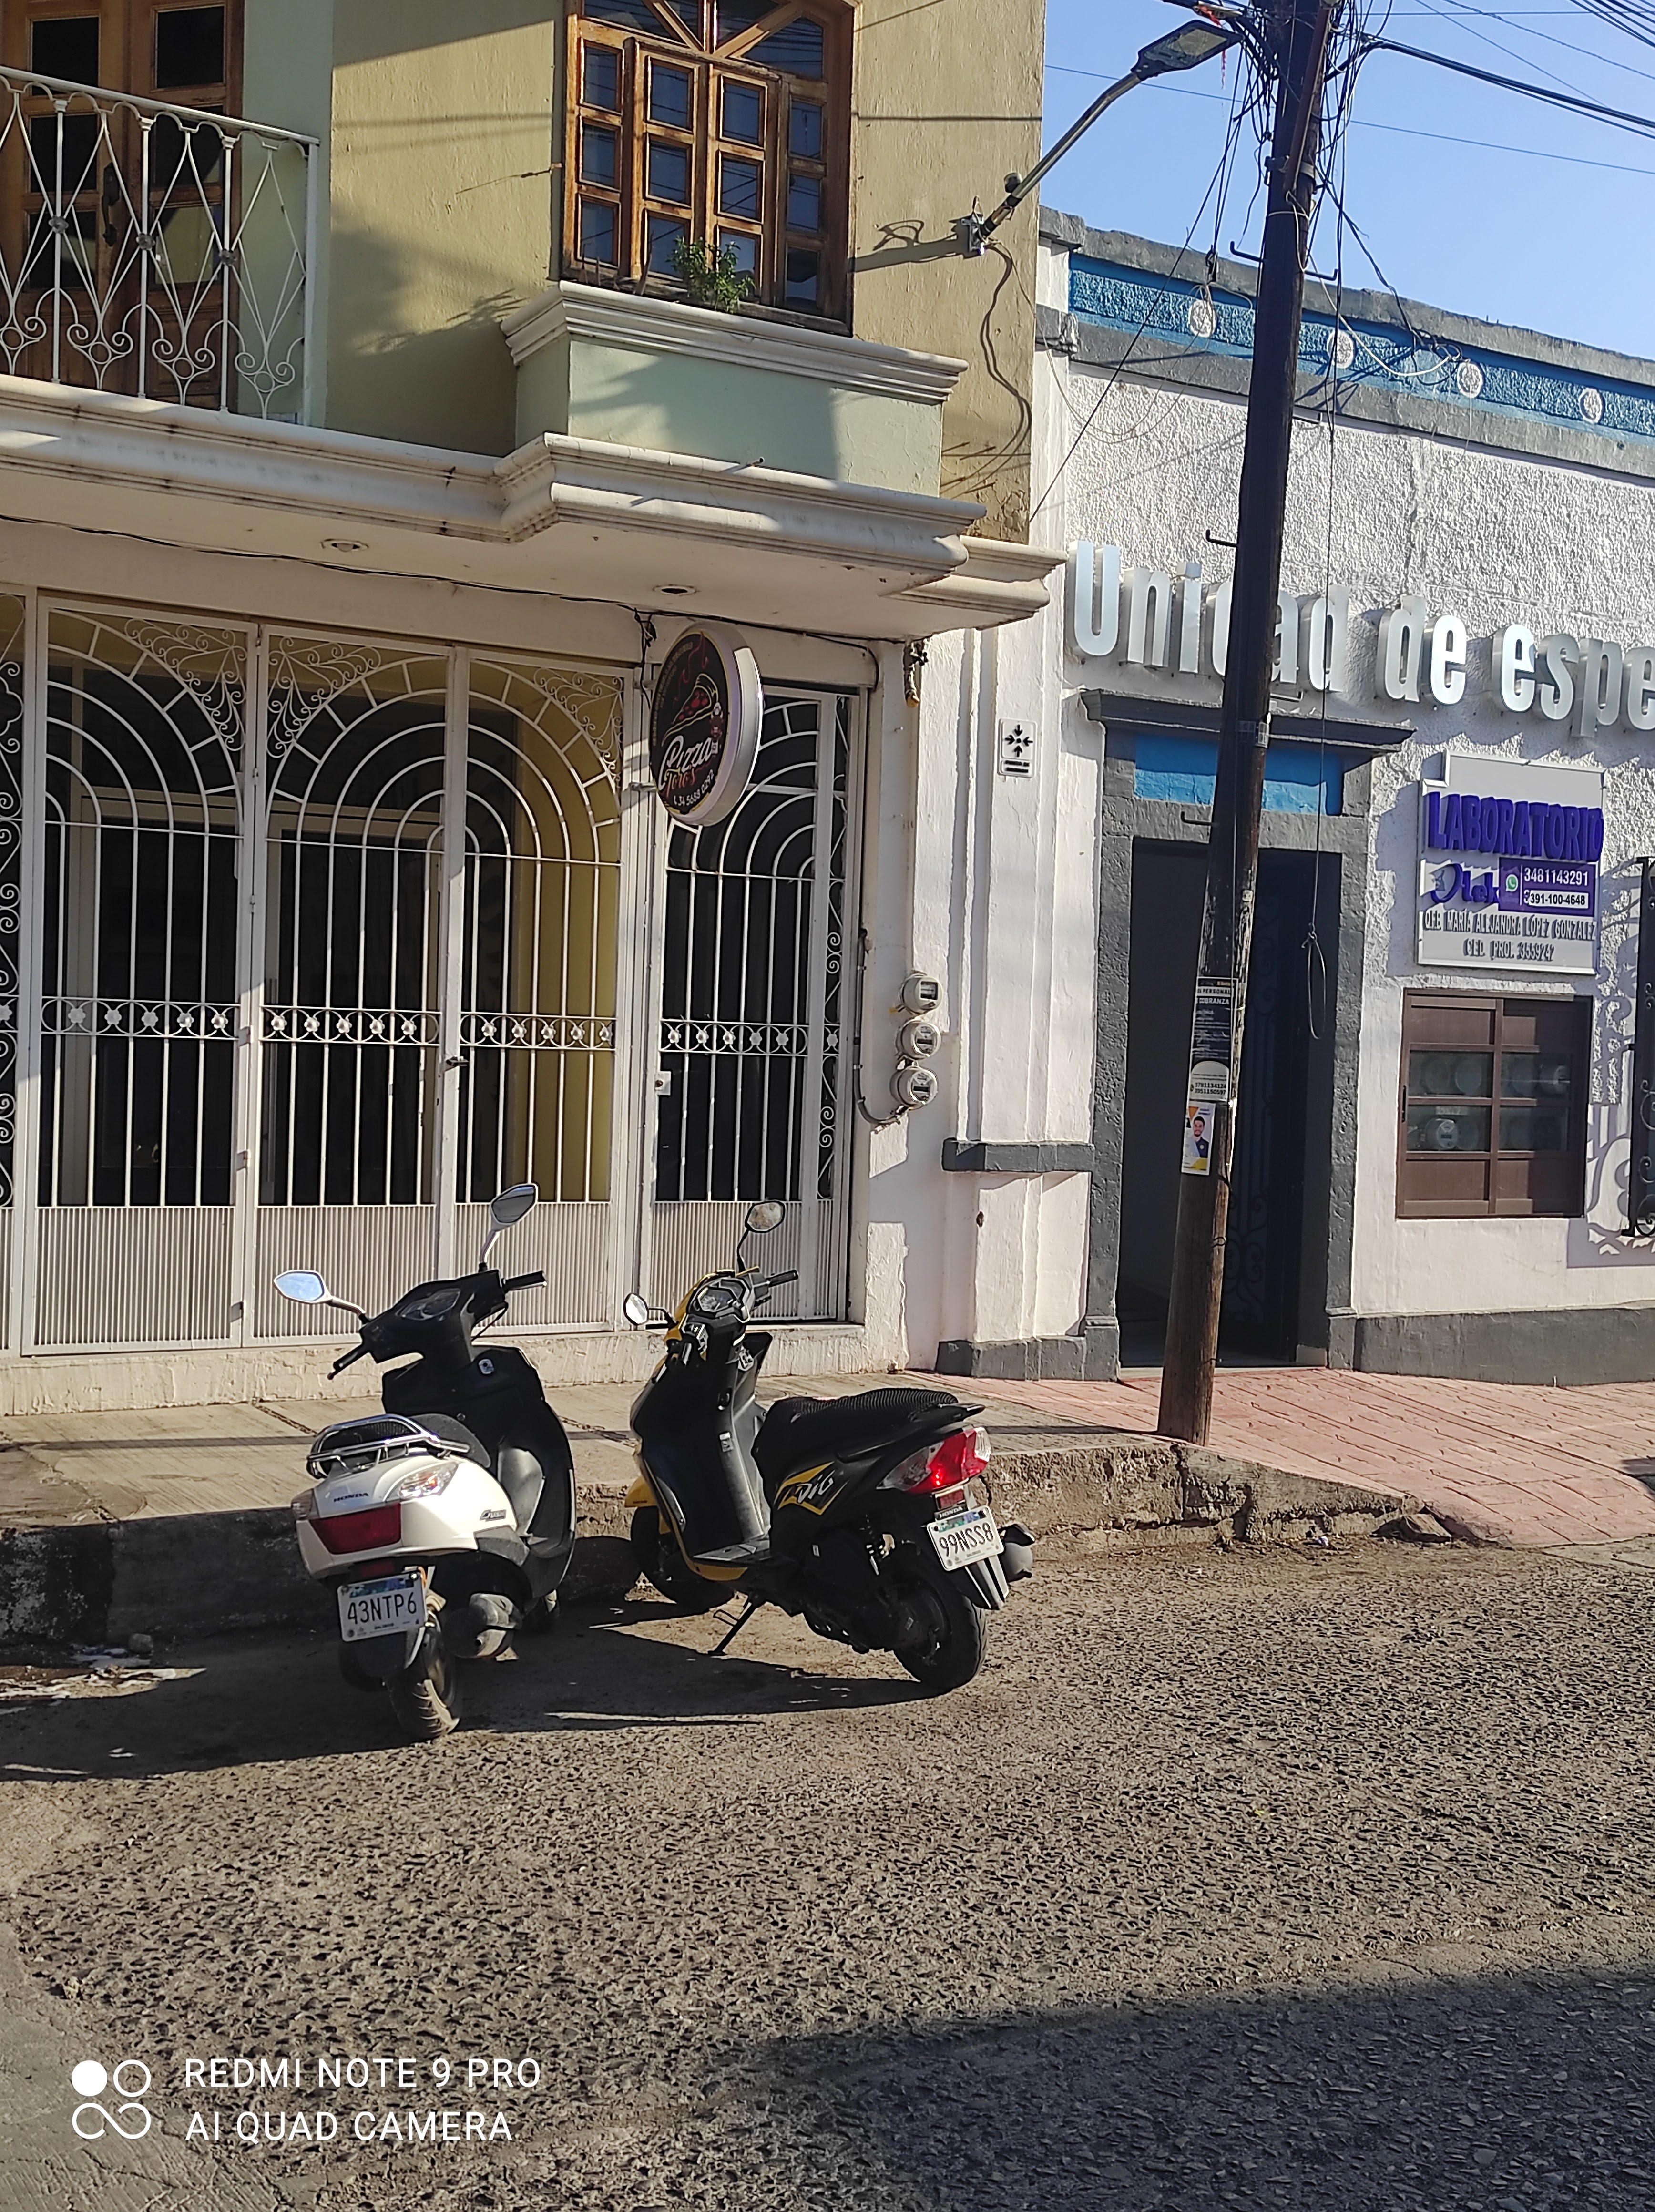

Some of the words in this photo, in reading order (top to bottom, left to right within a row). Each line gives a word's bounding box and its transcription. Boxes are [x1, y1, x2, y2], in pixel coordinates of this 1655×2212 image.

[1379, 594, 1467, 705] de
[1493, 623, 1655, 737] espe
[658, 735, 712, 790] Pizza
[1428, 791, 1604, 862] LABORATORIO
[1524, 867, 1588, 886] 3481143291
[1531, 893, 1585, 905] 391-100-4648
[1475, 912, 1521, 935] ALEJANDRA
[334, 1493, 369, 1502] HONDA
[939, 1506, 963, 1518] HONDA
[939, 1522, 993, 1557] 99NSS8
[347, 1592, 417, 1625] 43NTP6
